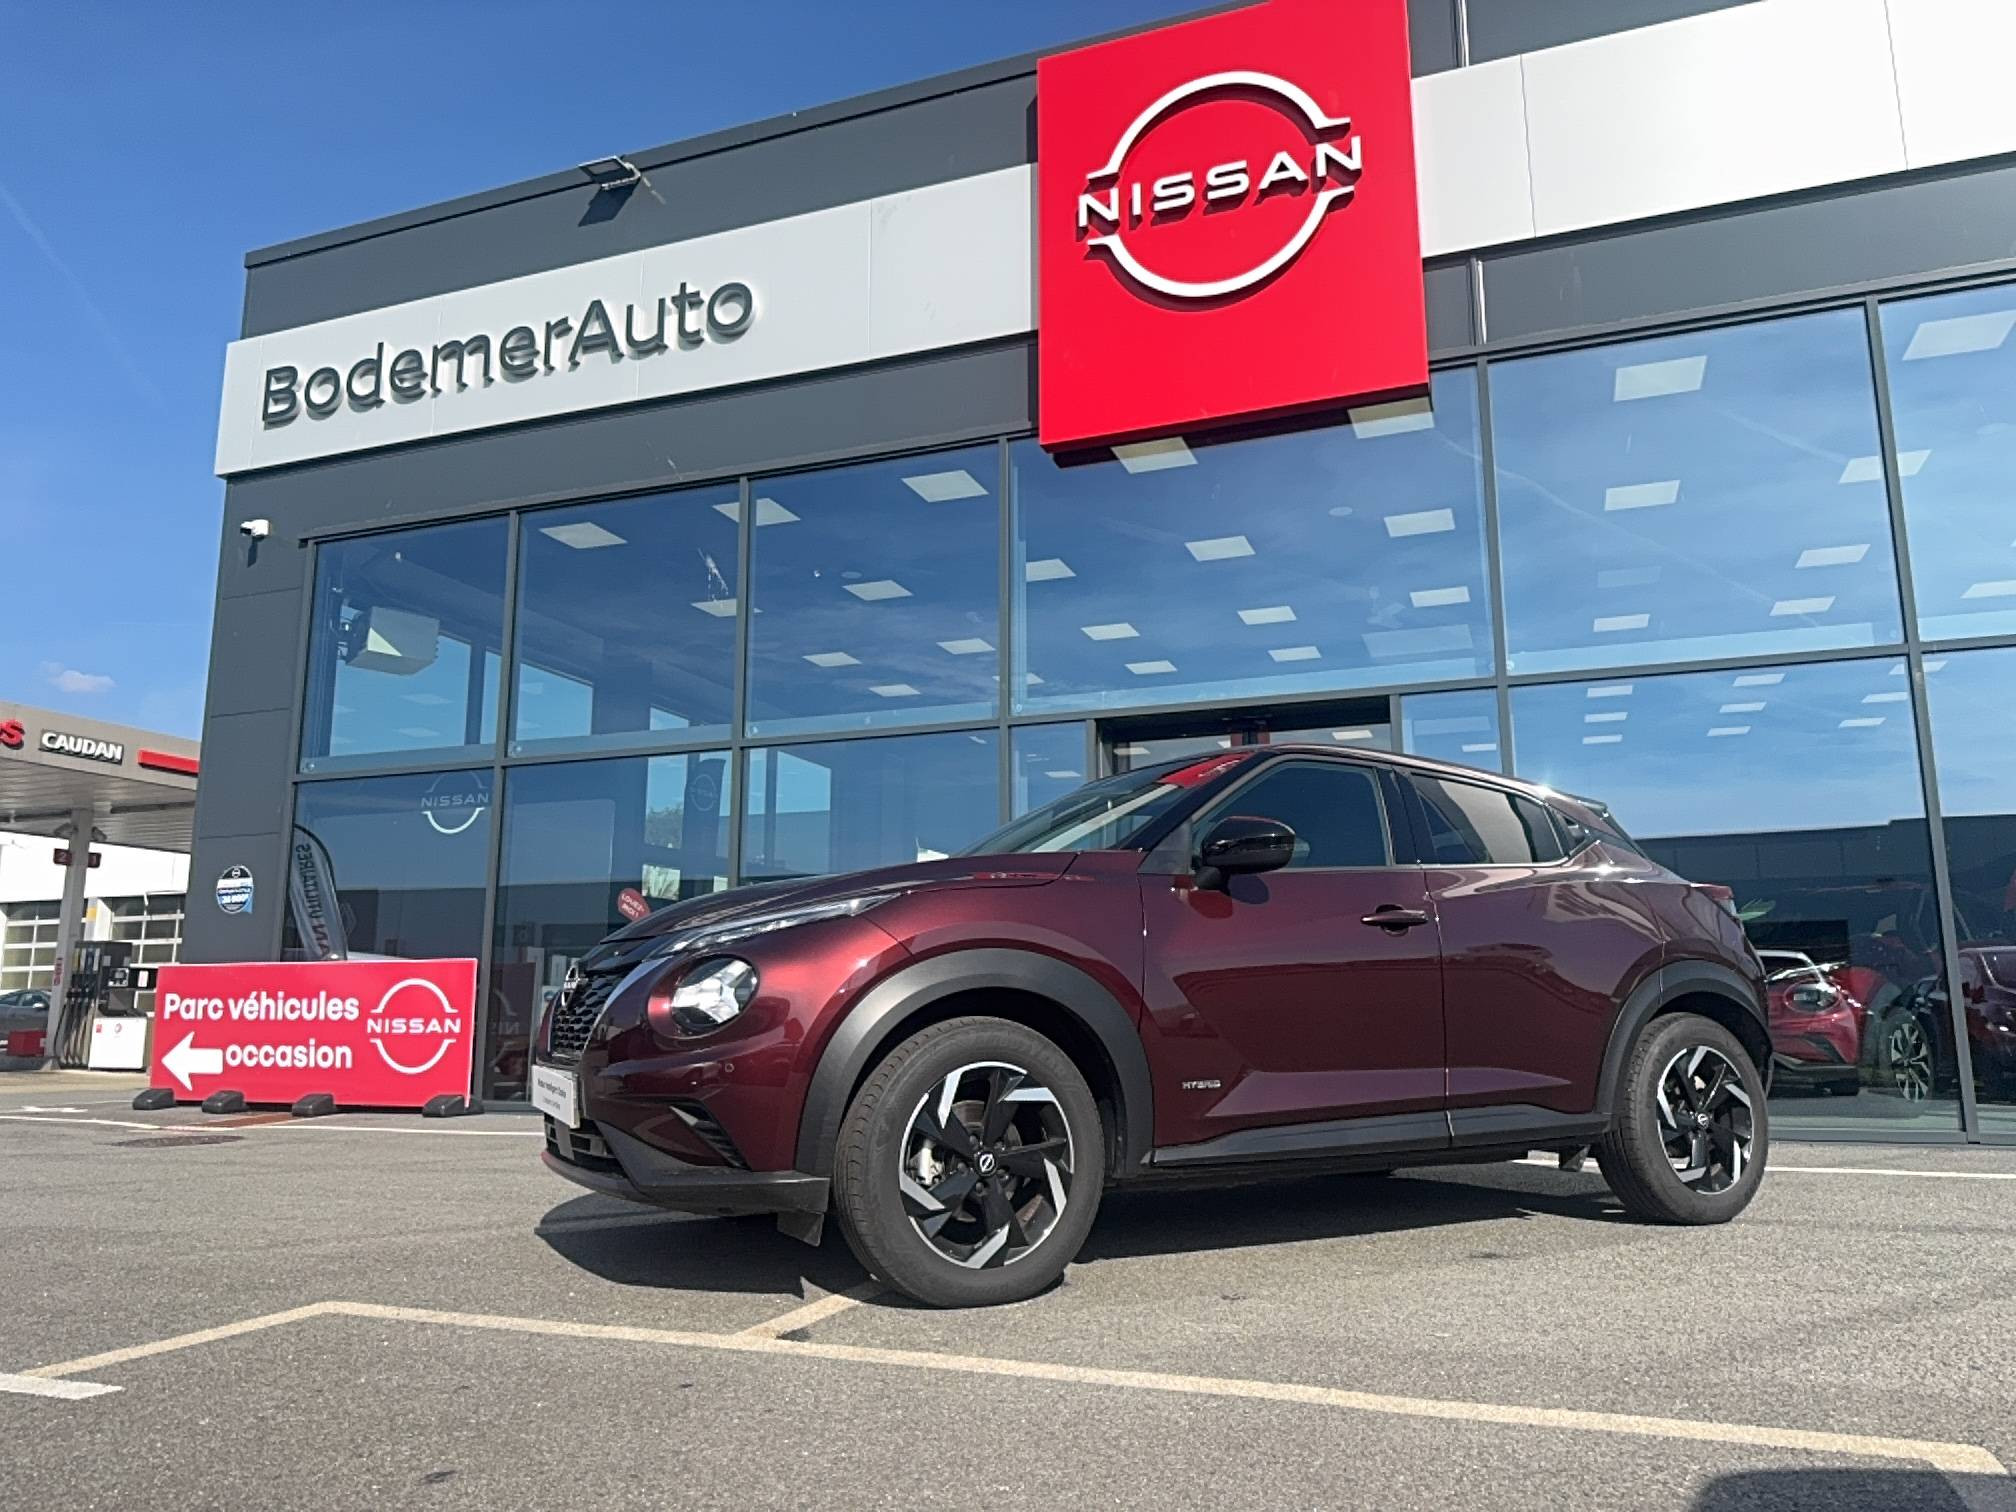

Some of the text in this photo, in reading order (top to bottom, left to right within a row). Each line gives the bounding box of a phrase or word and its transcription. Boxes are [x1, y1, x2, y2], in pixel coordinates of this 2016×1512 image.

[1078, 136, 1362, 228] NISSAN
[262, 281, 754, 426] BodemerAuto
[41, 732, 122, 760] CAUDAN
[421, 792, 489, 808] NISSAN
[164, 990, 360, 1021] Parc véhicules
[367, 1017, 461, 1034] NISSAN
[225, 1038, 353, 1069] occasion
